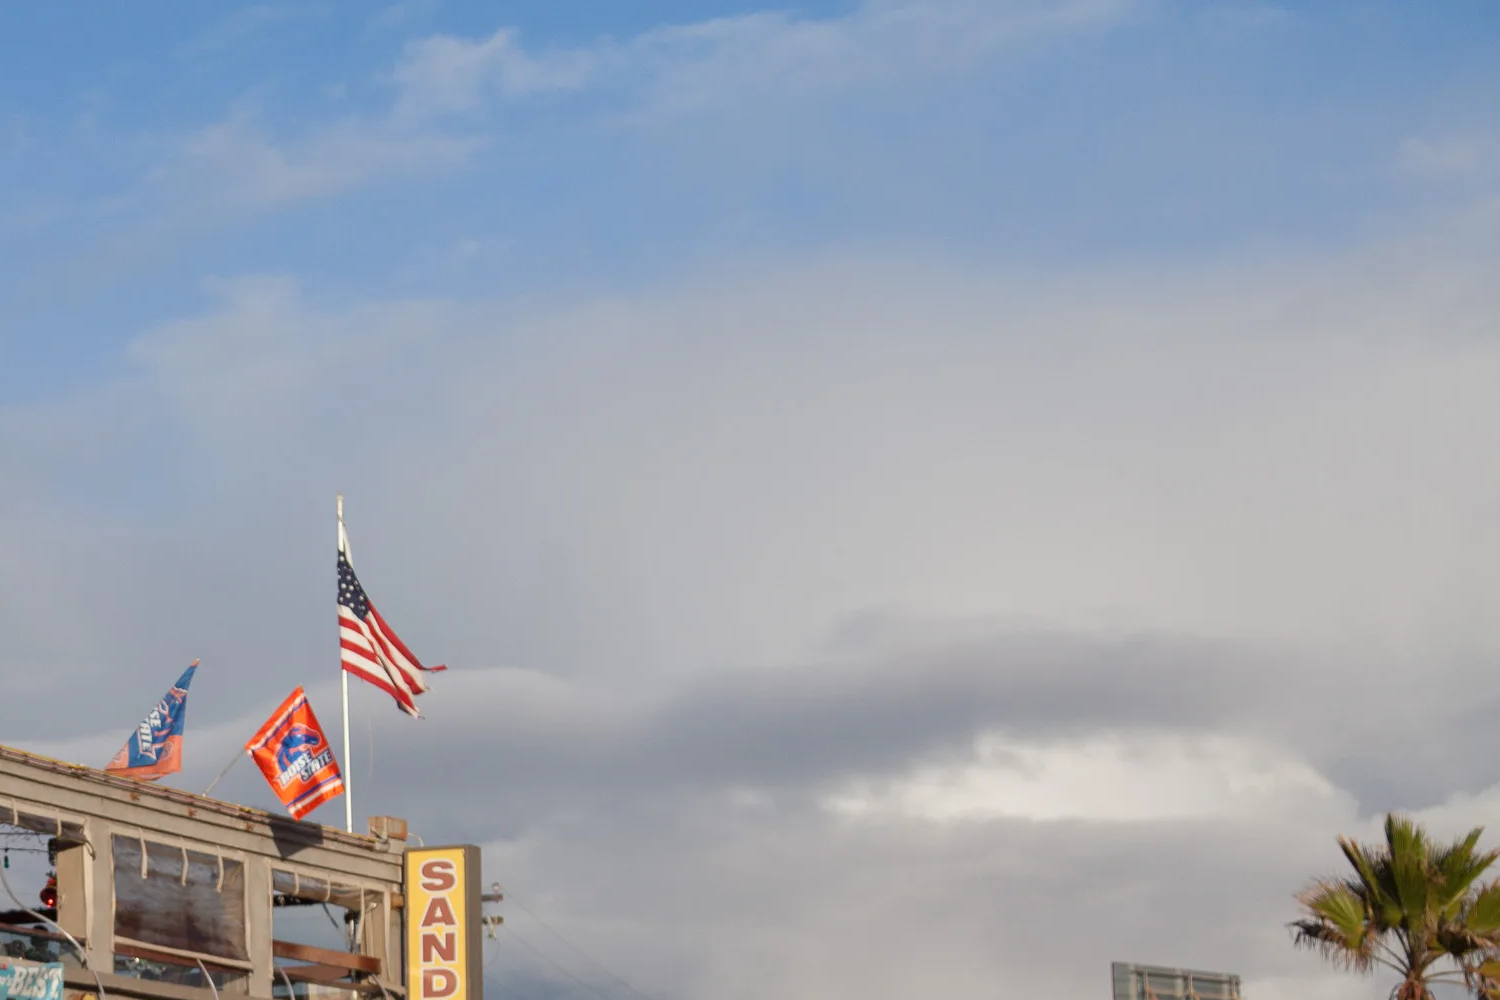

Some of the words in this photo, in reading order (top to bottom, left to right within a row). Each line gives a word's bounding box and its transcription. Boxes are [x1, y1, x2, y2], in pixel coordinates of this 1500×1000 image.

[280, 750, 312, 786] BOISE
[301, 750, 333, 781] STATE
[7, 965, 63, 999] BEST
